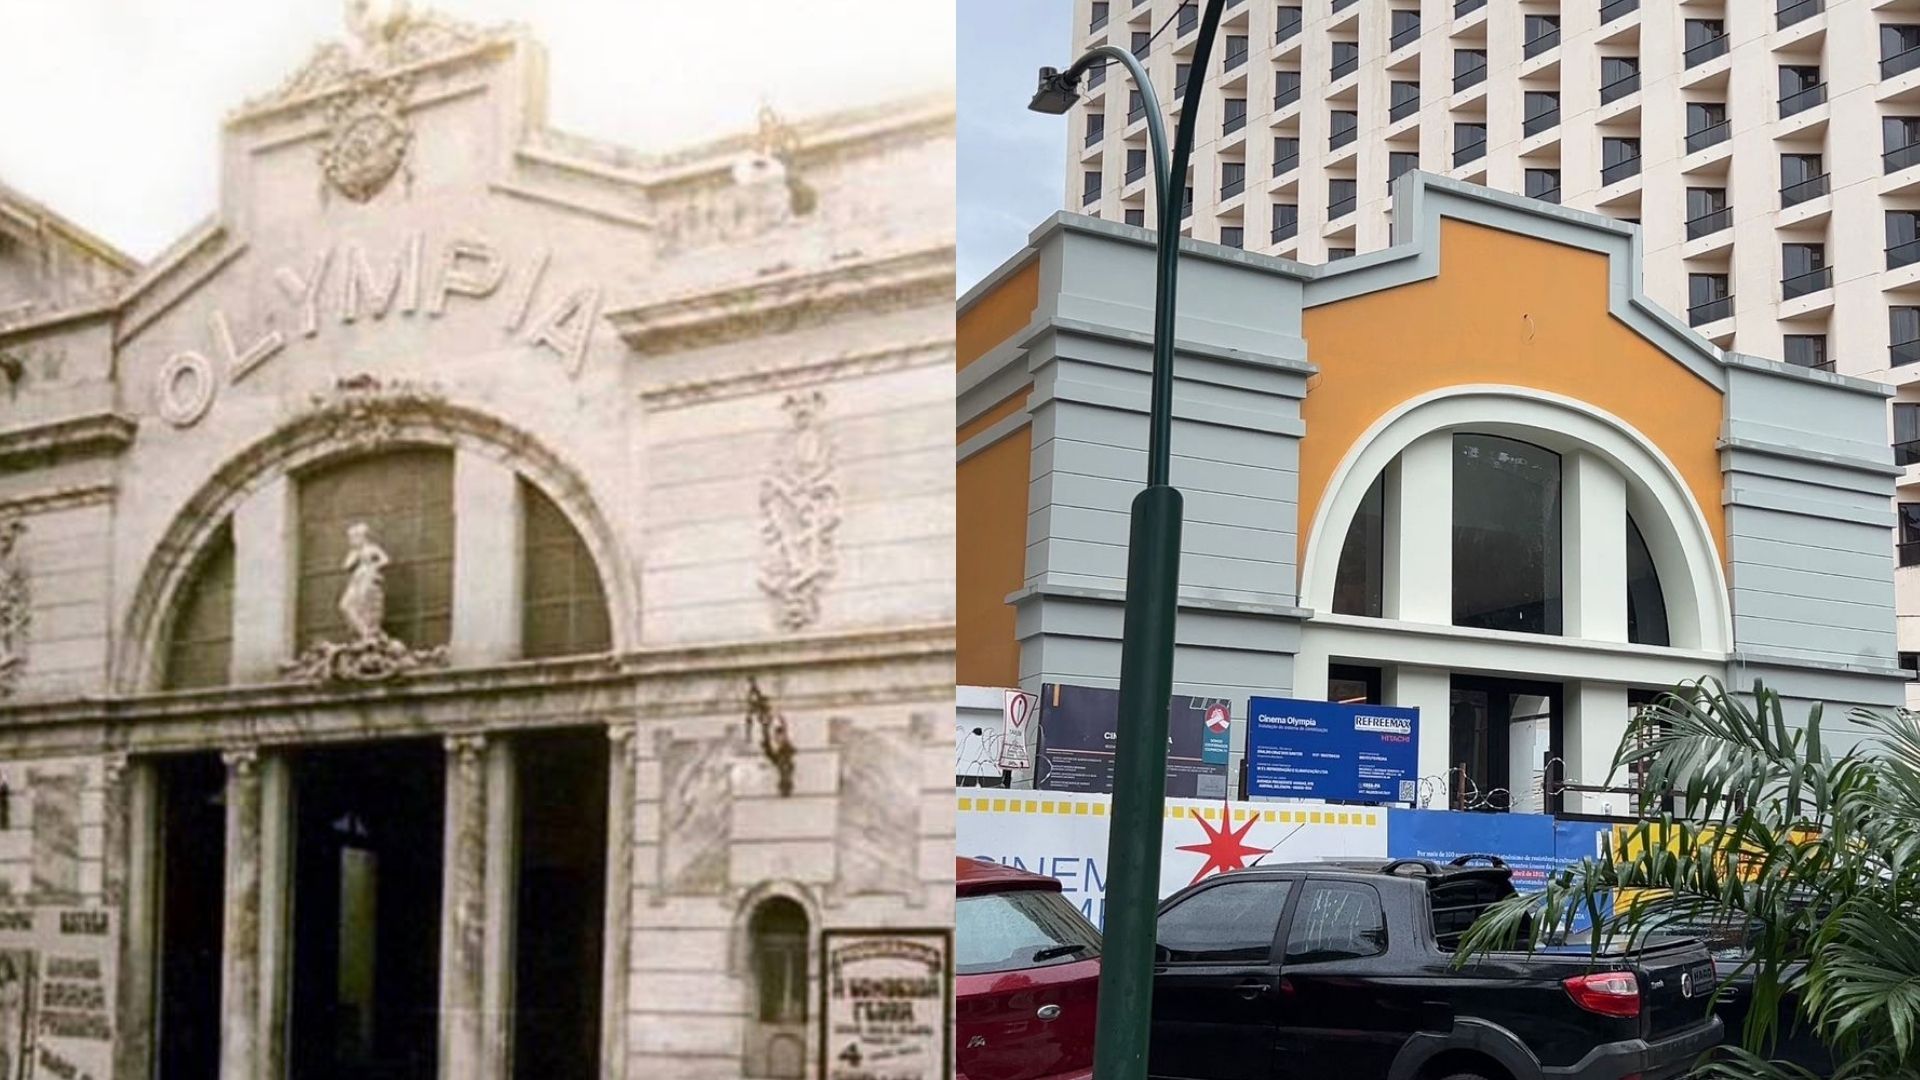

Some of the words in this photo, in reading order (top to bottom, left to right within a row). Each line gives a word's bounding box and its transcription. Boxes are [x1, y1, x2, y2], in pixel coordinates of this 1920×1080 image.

[158, 232, 603, 428] OLYMPIA
[1258, 714, 1287, 724] Cinema
[1287, 716, 1317, 727] Olympia
[1355, 716, 1411, 729] REFREEMAX
[1381, 735, 1411, 743] HITACHI
